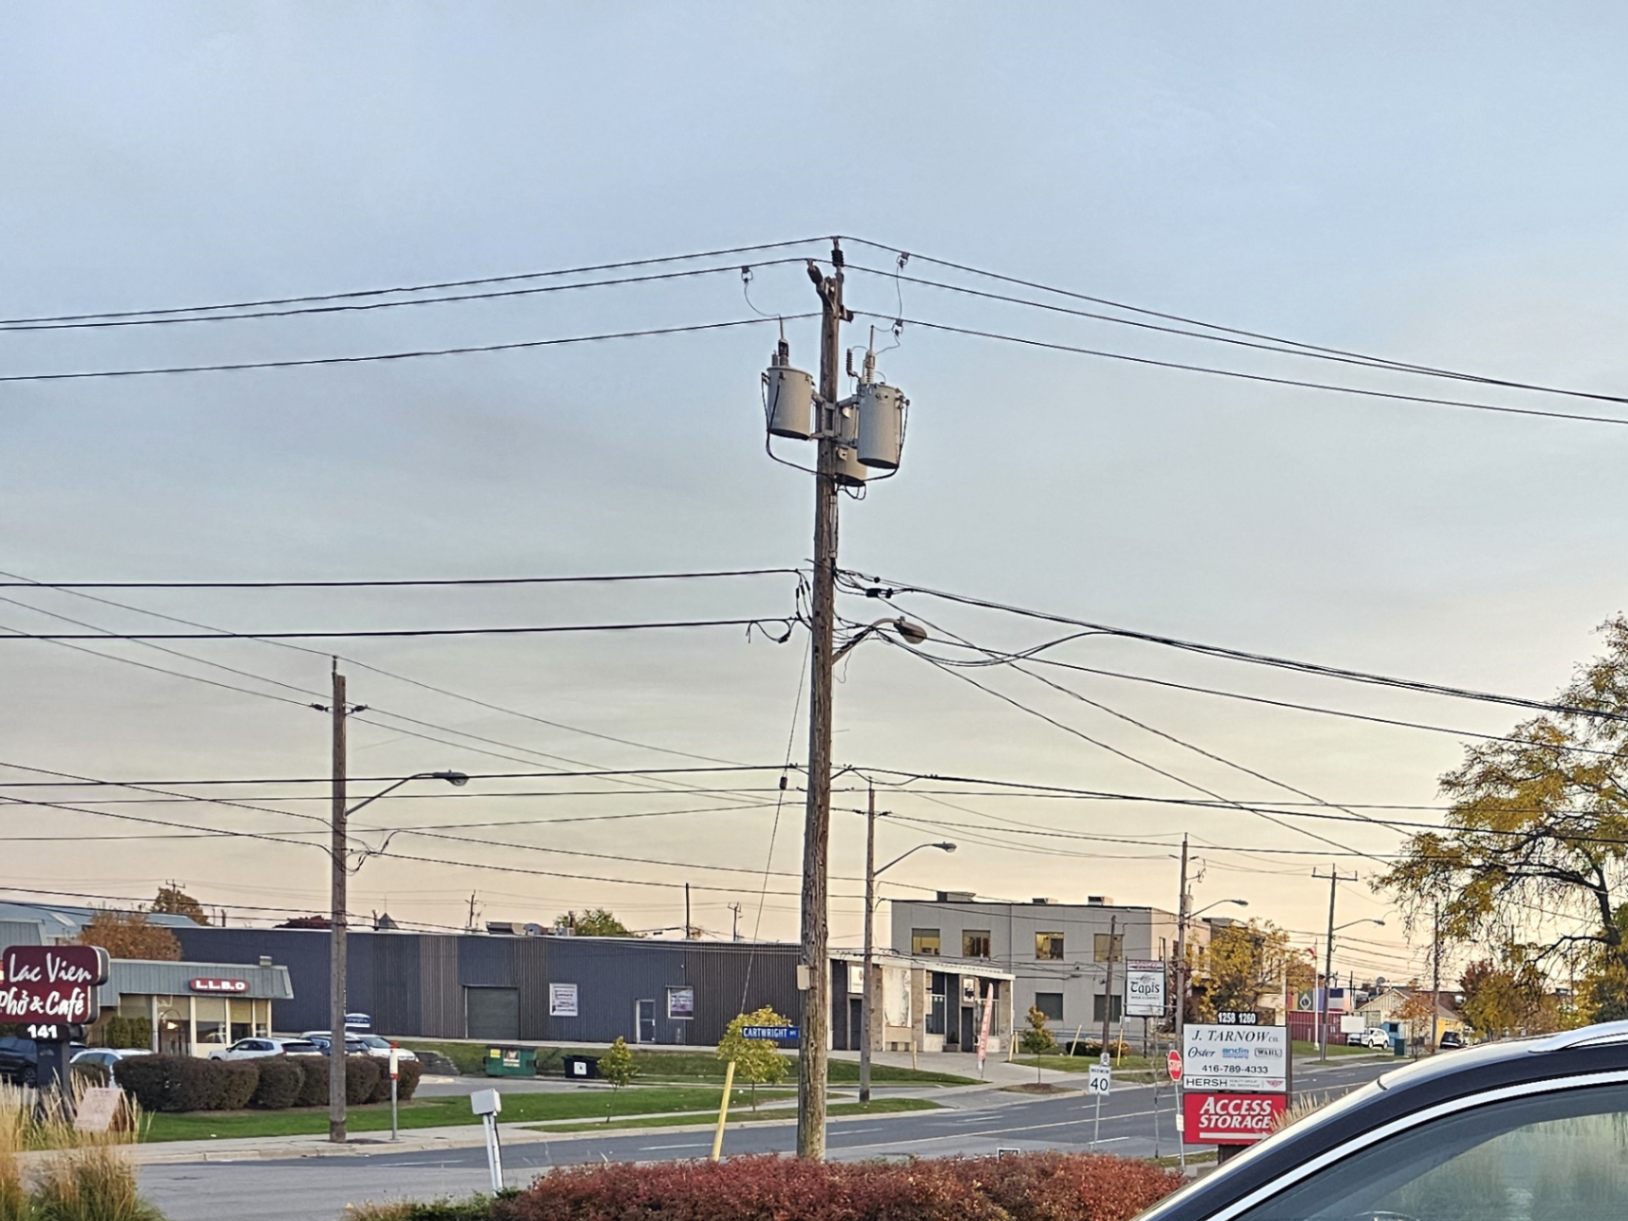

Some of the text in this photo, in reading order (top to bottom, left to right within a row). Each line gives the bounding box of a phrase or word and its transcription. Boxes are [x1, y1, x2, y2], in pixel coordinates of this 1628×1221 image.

[9, 952, 92, 983] Lac Vien
[1130, 980, 1160, 996] Tapis
[29, 995, 44, 1014] &
[45, 987, 85, 1023] Café
[27, 1024, 58, 1039] 141
[743, 1028, 788, 1038] CARTWRIGHT
[1192, 1030, 1202, 1041] J.
[1208, 1030, 1269, 1042] TARNOW
[1187, 1047, 1216, 1058] Oster
[1202, 1065, 1268, 1073] 416-789-4333
[1090, 1078, 1109, 1091] 40
[1186, 1078, 1227, 1087] HERSH
[1199, 1096, 1272, 1115] ACCESS
[1199, 1115, 1271, 1128] STORAGE
